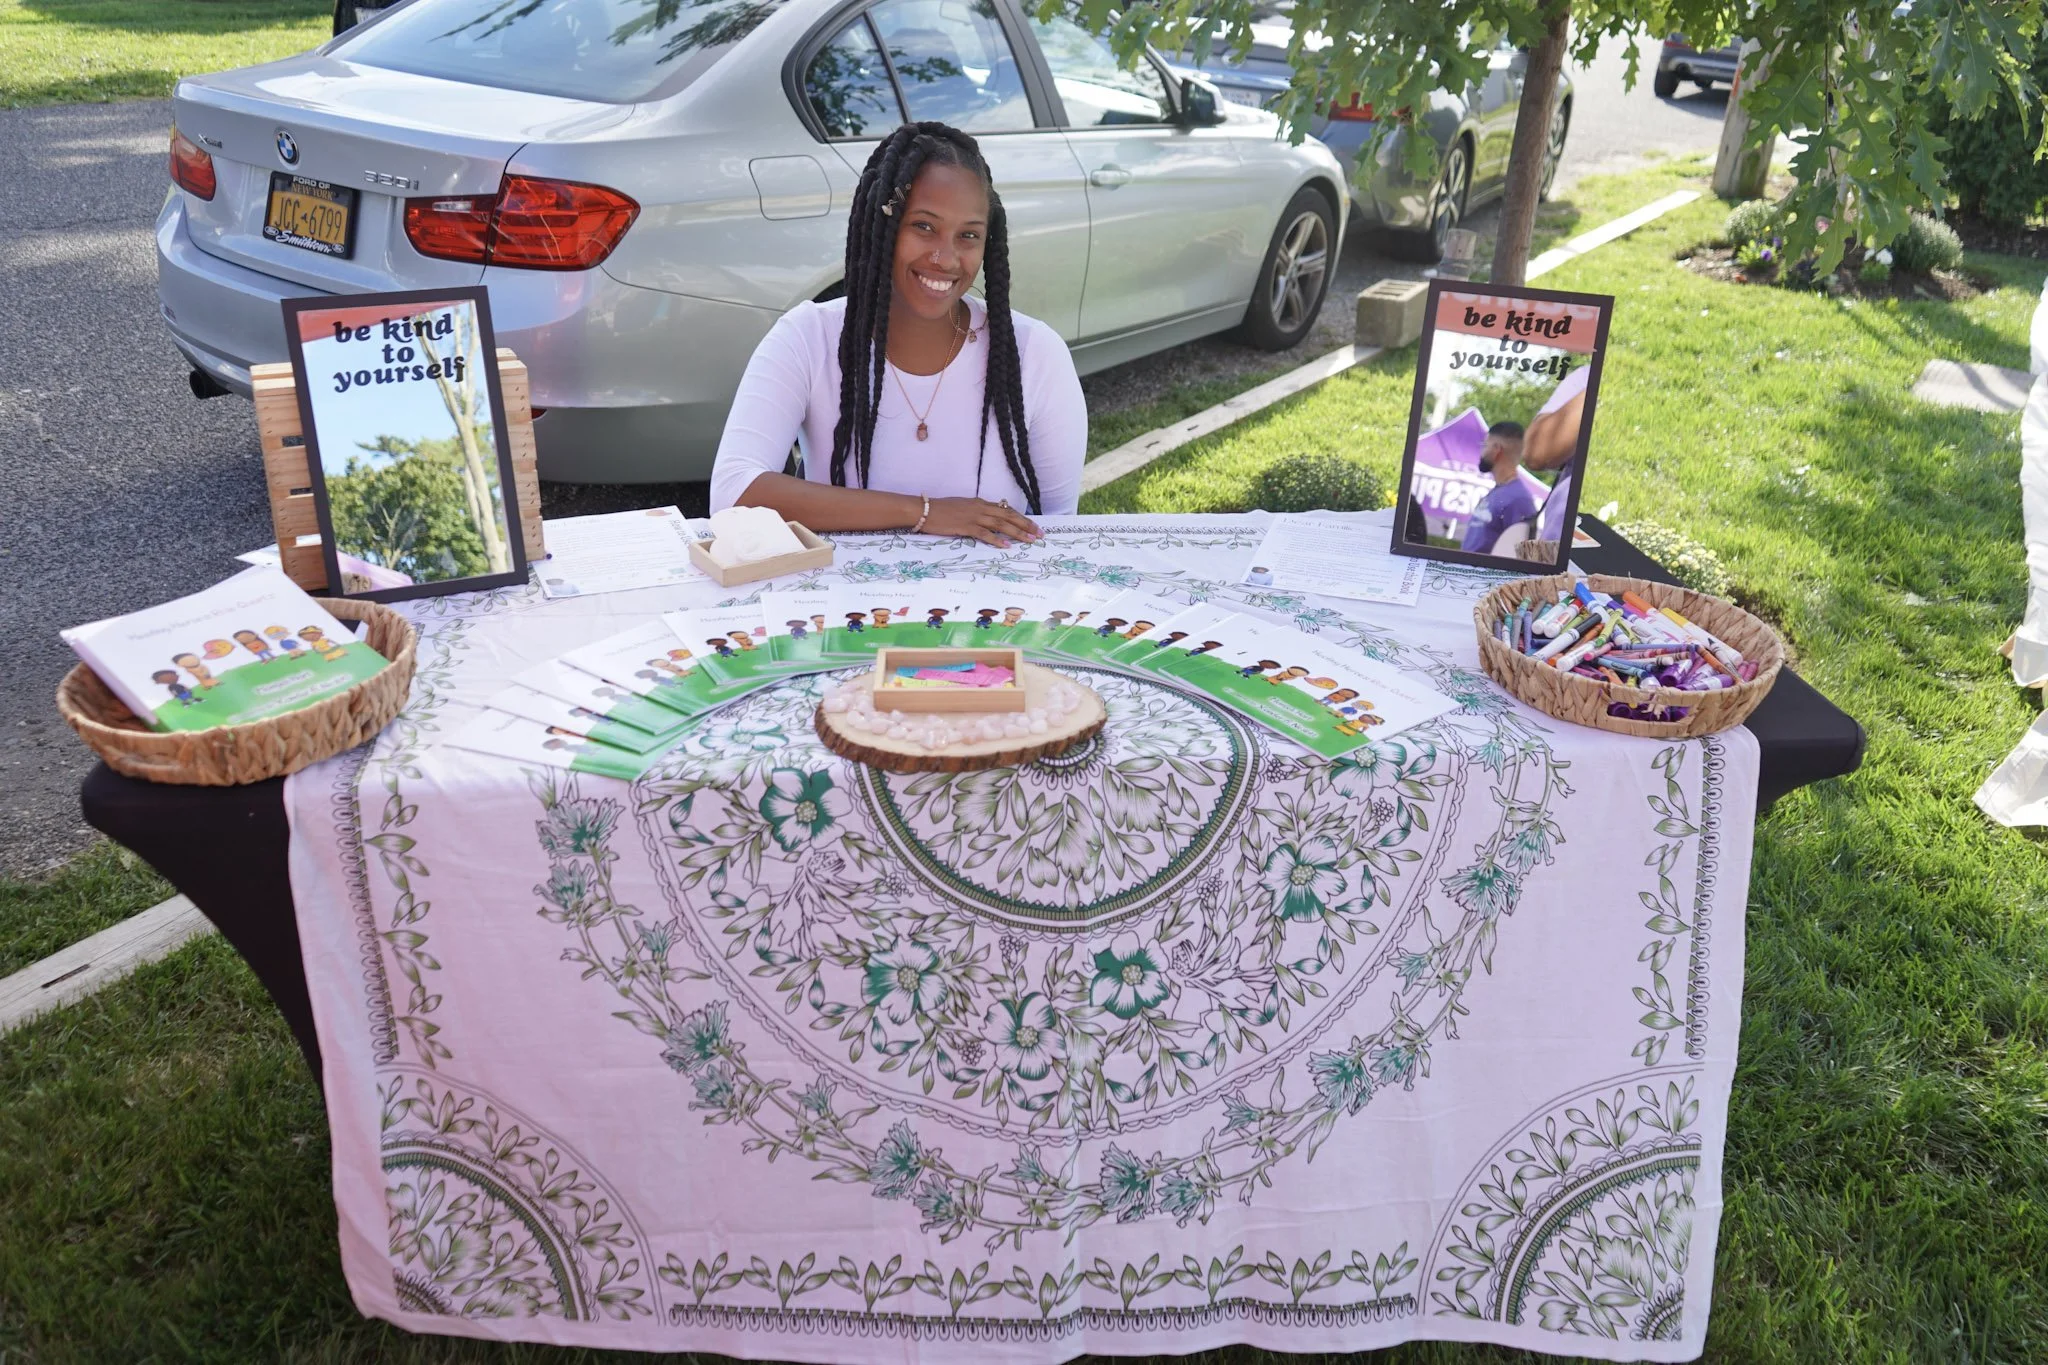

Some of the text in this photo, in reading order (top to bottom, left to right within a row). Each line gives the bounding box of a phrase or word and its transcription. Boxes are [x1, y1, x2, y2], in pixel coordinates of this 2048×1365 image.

[292, 176, 331, 189] FORD OF
[292, 183, 334, 200] NEW YORK
[274, 197, 342, 241] JCC 6799
[276, 230, 332, 254] Smithtown
[333, 313, 454, 343] be kind
[1463, 307, 1573, 338] be kind
[381, 344, 415, 364] to
[1499, 334, 1529, 353] to
[333, 356, 465, 393] yourself
[1450, 350, 1572, 381] yourself
